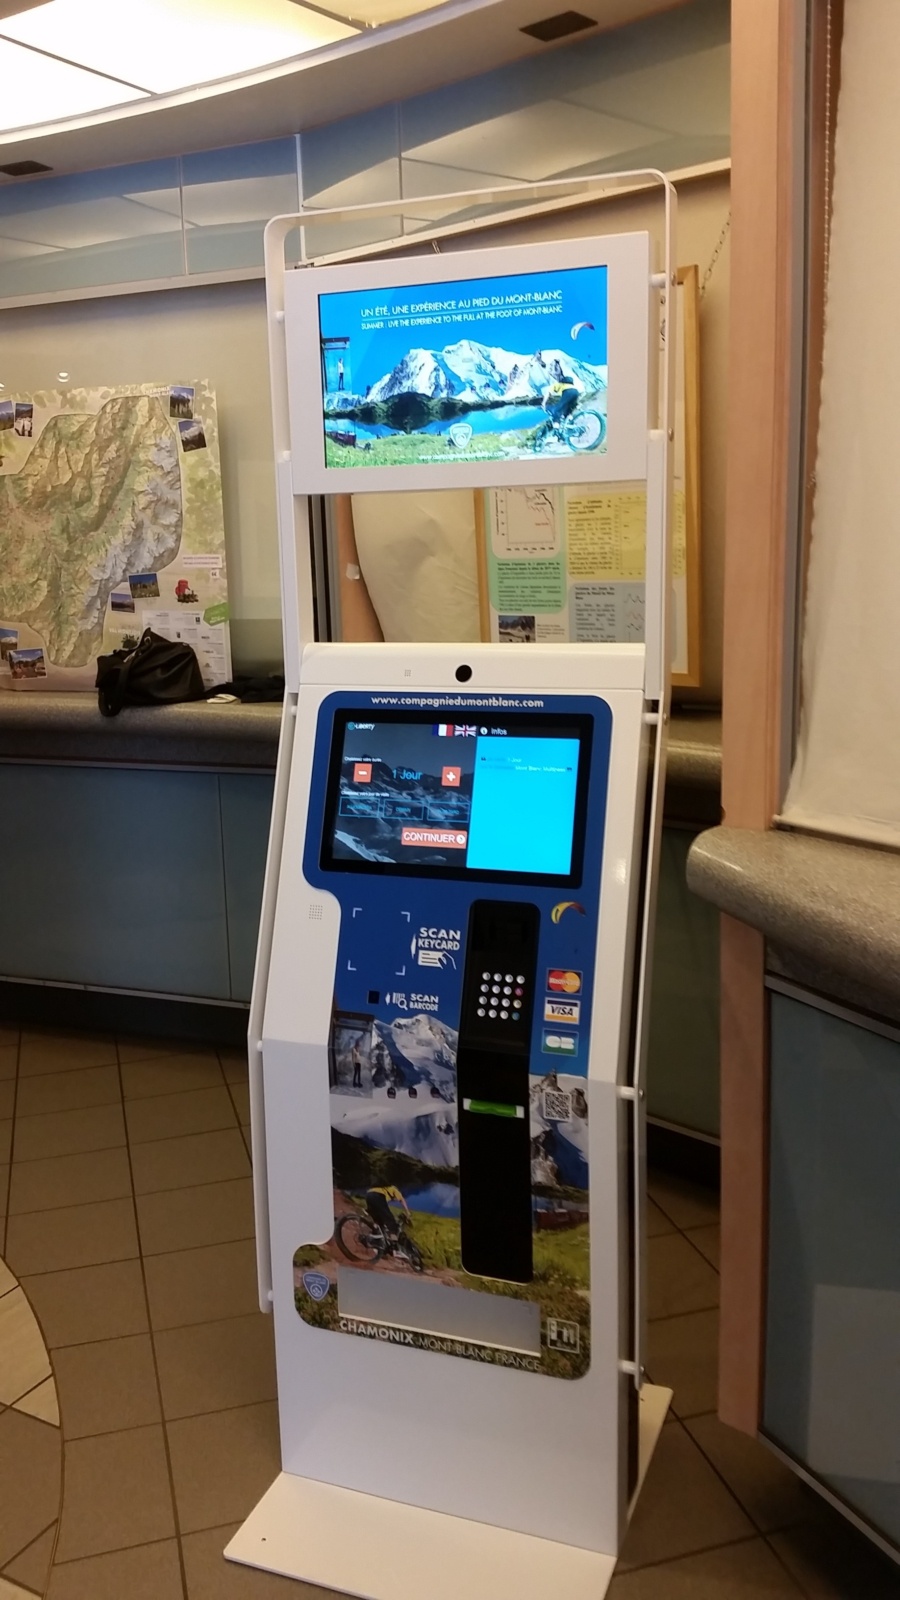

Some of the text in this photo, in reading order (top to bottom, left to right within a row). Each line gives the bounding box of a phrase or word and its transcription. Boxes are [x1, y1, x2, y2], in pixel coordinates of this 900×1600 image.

[361, 290, 562, 317] UN ÉTÉ, UNE EXPÉRIENCE AU PIED DU MONT-BLANC
[361, 321, 384, 330] SUMMER
[388, 320, 399, 328] LIVE
[400, 319, 410, 327] THE
[410, 316, 442, 326] EXPERIENCE
[443, 315, 451, 323] TO
[451, 314, 462, 322] THE
[463, 313, 475, 321] FULL
[476, 312, 484, 320] AT
[484, 311, 495, 319] THE
[496, 310, 513, 318] FOOT
[513, 308, 522, 316] OF
[523, 305, 562, 316] MONT-BLANC
[371, 695, 544, 708] www.compagniedumontblanc.com
[490, 727, 508, 736] Infos
[392, 769, 423, 780] 1 Jour
[403, 831, 456, 844] CONTINUER
[419, 927, 461, 940] SCAN
[417, 938, 460, 951] KEYCARD
[410, 993, 439, 1003] SCAN
[409, 1001, 439, 1011] BARCODE
[551, 1005, 574, 1016] VISA
[340, 1320, 414, 1345] CHAMONIX
[494, 1351, 541, 1371] FRANCE
